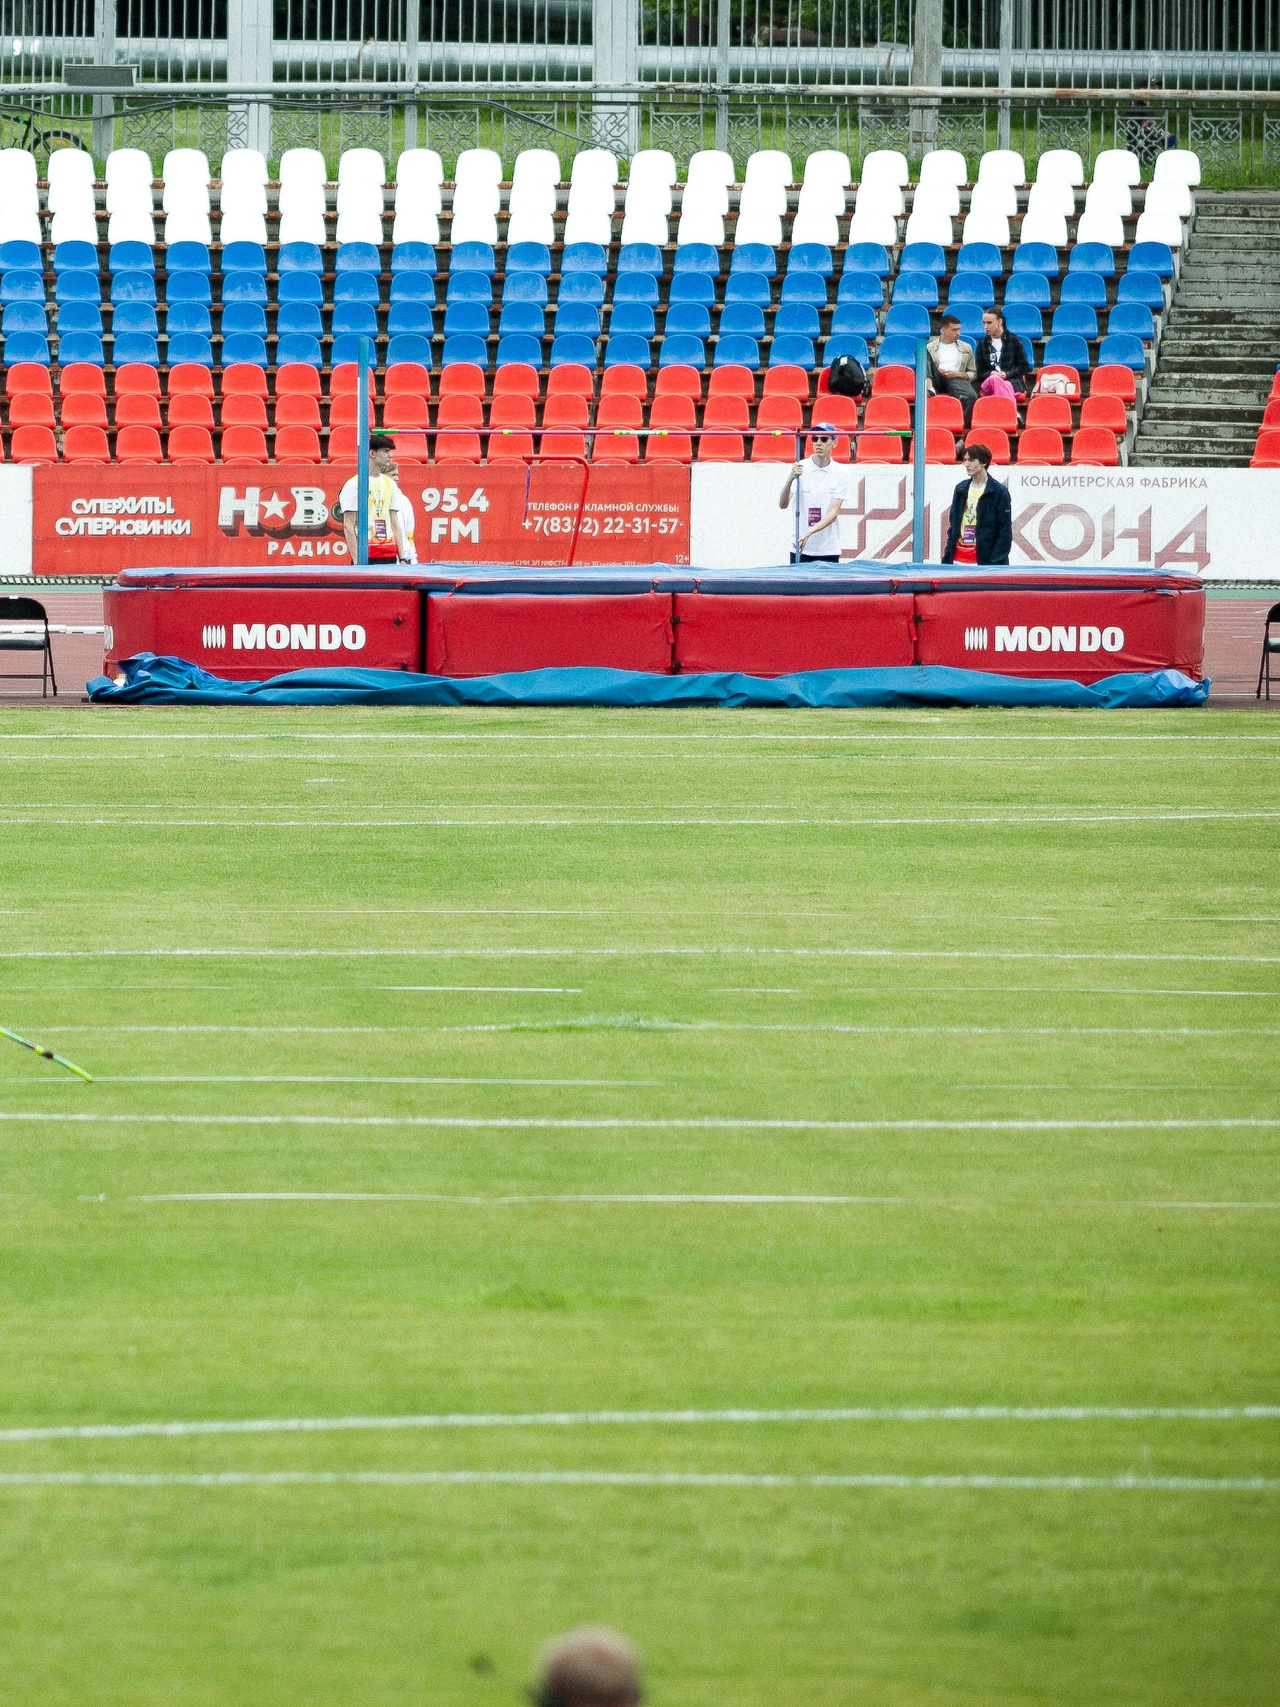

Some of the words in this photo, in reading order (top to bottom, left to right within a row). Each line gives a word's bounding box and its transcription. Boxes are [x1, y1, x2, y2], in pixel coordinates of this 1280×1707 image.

[1021, 475, 1134, 488] КОНДИТЕРСКАЯ
[1140, 477, 1208, 488] ФАБРИКА
[421, 488, 489, 513] 95.4
[528, 502, 572, 511] ТЕЛЕФОН
[574, 502, 634, 512] РКЛАМНОЙ
[635, 503, 679, 513] СЛУЖБЫ:
[430, 517, 480, 544] FM
[603, 517, 679, 534] 22-31-57
[267, 541, 348, 558] РАДИО
[675, 554, 689, 564] 12+
[232, 624, 367, 650] MONDO
[994, 626, 1125, 652] MONDO
